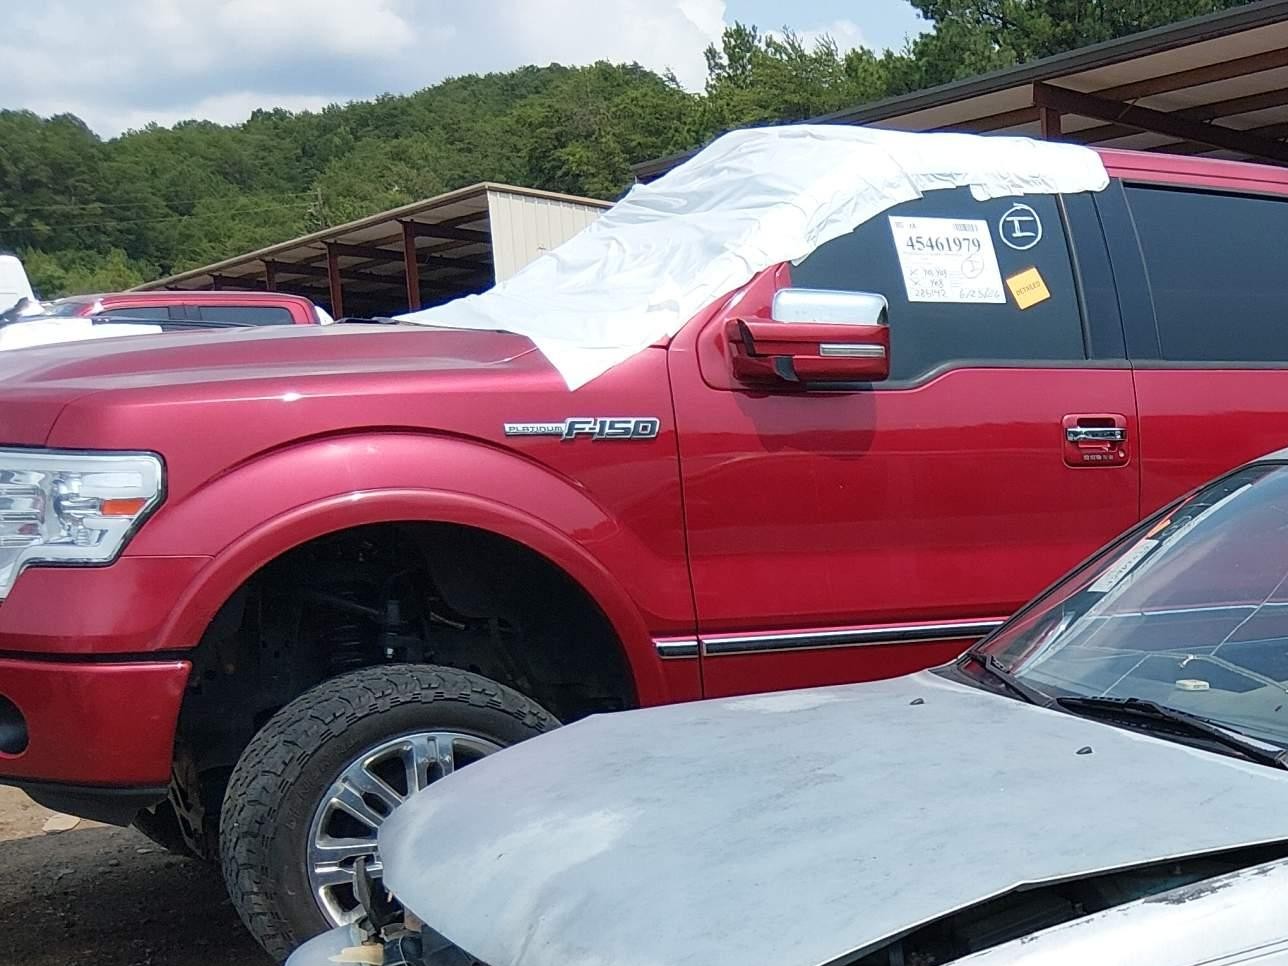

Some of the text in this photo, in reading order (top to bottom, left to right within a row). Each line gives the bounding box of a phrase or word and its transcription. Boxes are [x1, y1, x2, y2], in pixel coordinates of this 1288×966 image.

[906, 236, 981, 252] 45461979
[1015, 280, 1041, 297] DETAILED
[507, 417, 660, 441] PLATINUM F-150
